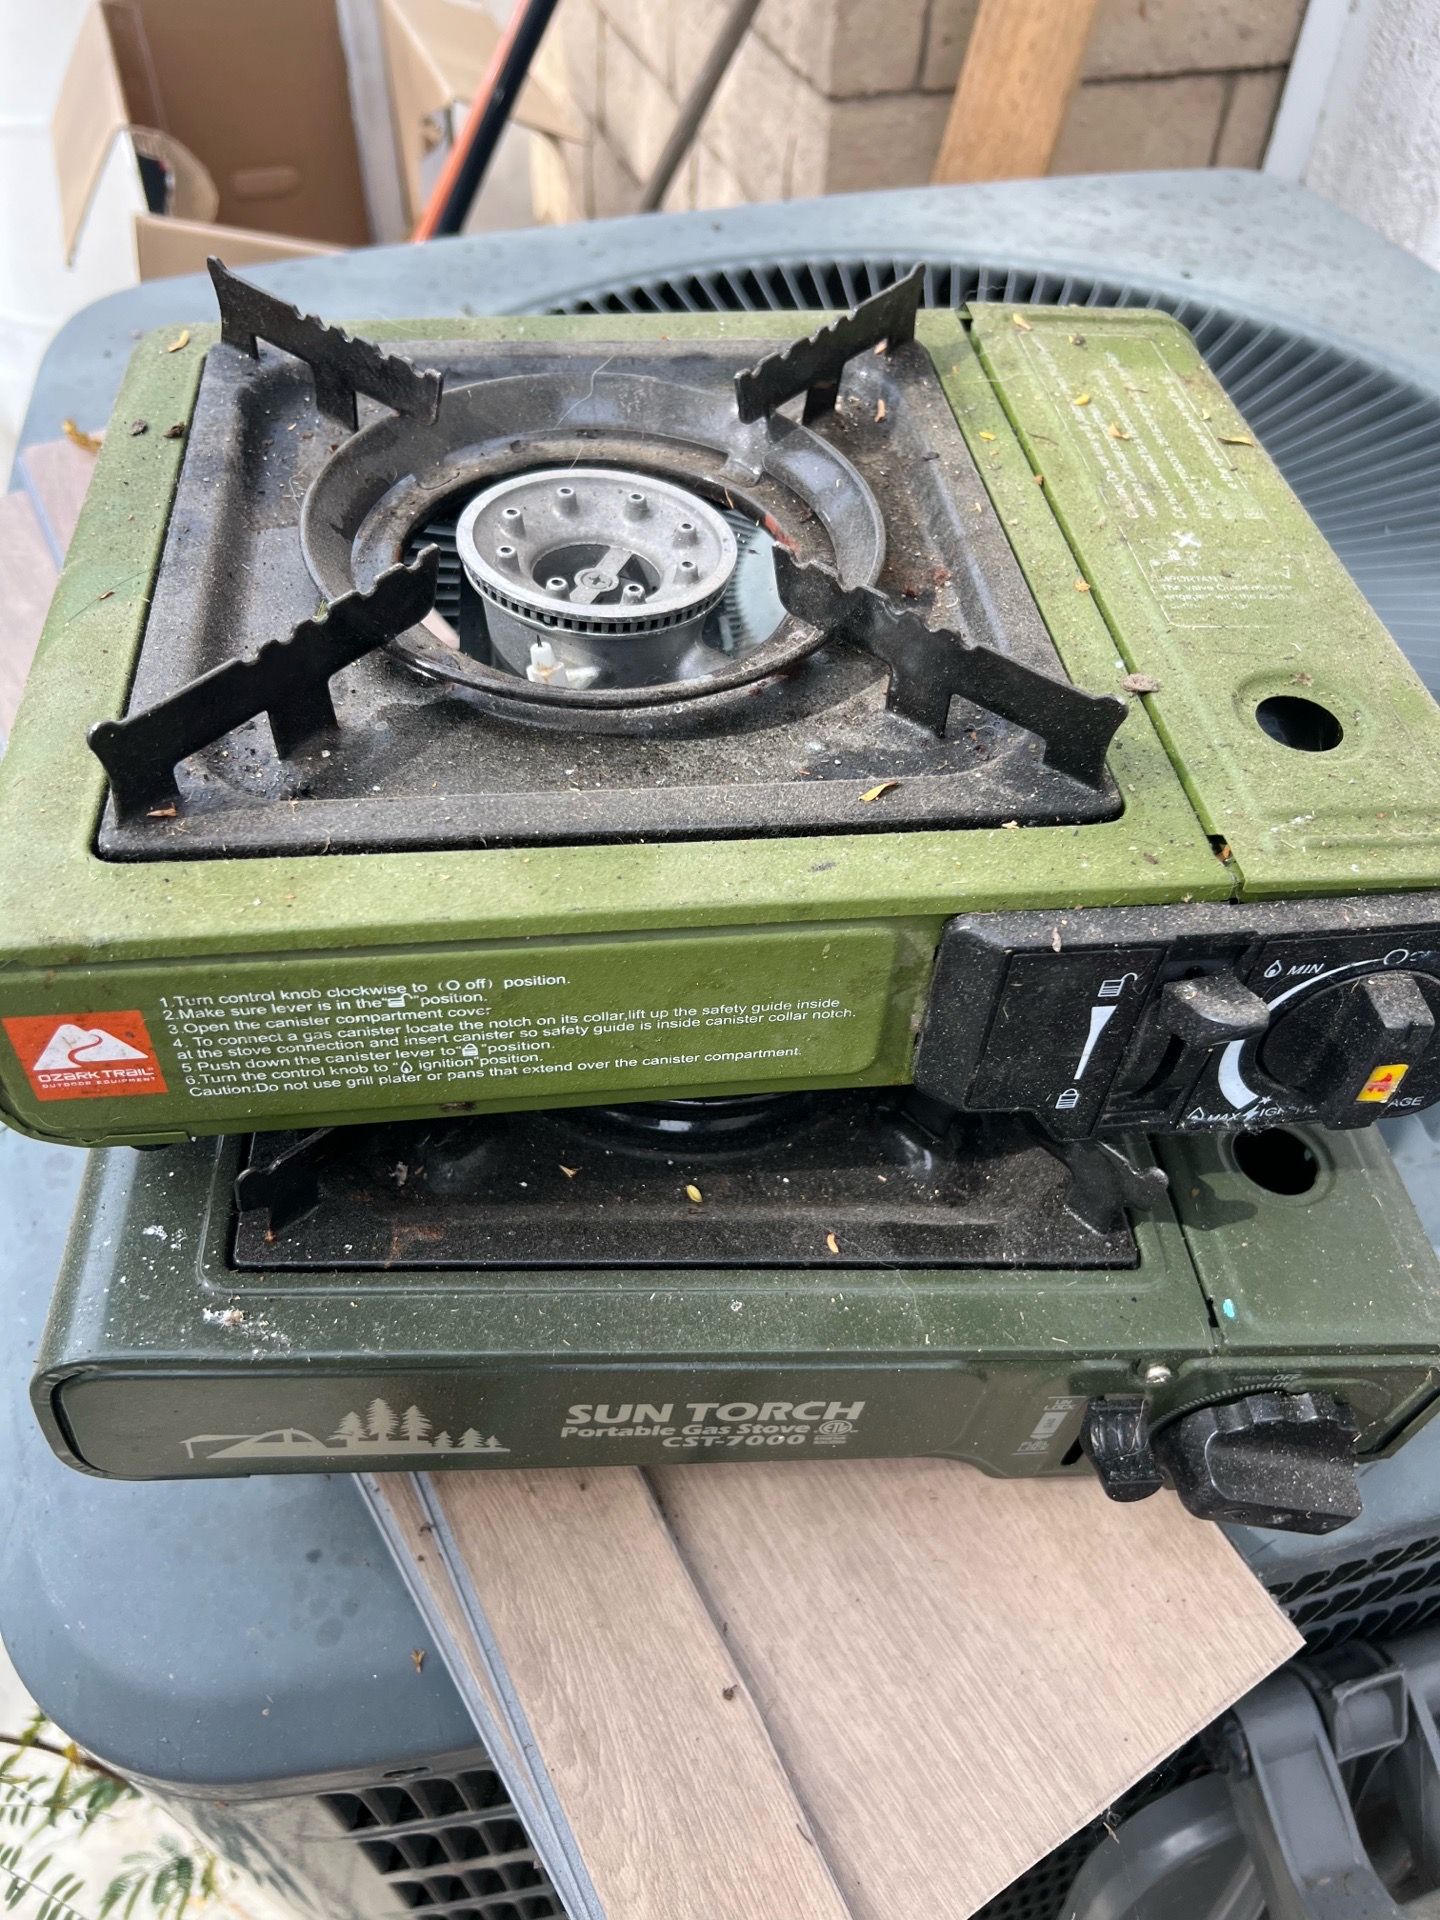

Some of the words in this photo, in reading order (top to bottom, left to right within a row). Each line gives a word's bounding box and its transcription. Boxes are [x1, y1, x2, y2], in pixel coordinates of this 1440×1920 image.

[1286, 962, 1325, 976] MIN
[218, 990, 276, 1005] control
[279, 988, 322, 1002] knob
[327, 982, 407, 998] clockwise
[411, 982, 428, 994] to
[503, 974, 571, 990] position.
[230, 1004, 268, 1017] sure
[271, 1002, 313, 1014] lever
[317, 1000, 332, 1011] is
[336, 999, 351, 1010] in
[234, 1019, 261, 1032] the
[265, 1016, 331, 1029] canister
[336, 1007, 449, 1026] compartment
[177, 1050, 194, 1061] at
[196, 1048, 223, 1060] the
[228, 1045, 272, 1058] stove
[276, 1039, 365, 1054] connection
[369, 1037, 399, 1049] and
[404, 1034, 450, 1046] insert
[453, 1029, 515, 1043] canister
[519, 1029, 538, 1038] so
[542, 1025, 589, 1037] safety
[593, 1020, 635, 1036] guide
[640, 1020, 653, 1031] is
[656, 1017, 701, 1029] inside
[705, 1014, 764, 1027] canister
[768, 1011, 808, 1023] collar
[812, 1008, 857, 1020] notch.
[192, 1036, 213, 1048] To
[217, 1032, 284, 1046] connect
[287, 1033, 299, 1042] a
[302, 1031, 333, 1044] gas
[337, 1024, 401, 1039] canister
[406, 1022, 455, 1035] locate
[458, 1020, 484, 1032] the
[488, 1016, 532, 1029] notch
[536, 1016, 556, 1026] on
[561, 1014, 579, 1025] its
[649, 1009, 669, 1021] up
[674, 1006, 698, 1017] the
[702, 1003, 747, 1016] safety
[751, 1000, 792, 1014] guide
[796, 998, 840, 1010] inside
[244, 1057, 291, 1070] down
[294, 1054, 321, 1066] the
[325, 1047, 391, 1064] canister
[395, 1048, 435, 1060] lever
[283, 1081, 309, 1091] not
[312, 1078, 342, 1089] use
[346, 1075, 374, 1088] grill
[378, 1073, 422, 1086] plater
[426, 1071, 444, 1081] or
[447, 1068, 485, 1082] pans
[489, 1066, 518, 1077] that
[522, 1062, 573, 1075] extend
[577, 1059, 611, 1071] over
[614, 1058, 638, 1069] the
[642, 1054, 700, 1066] canister
[704, 1046, 802, 1062] compartment.
[241, 1071, 268, 1082] the
[271, 1067, 326, 1080] control
[329, 1064, 369, 1076] knob
[373, 1063, 389, 1073] to
[1206, 1112, 1241, 1121] MAX
[565, 1403, 675, 1425] SUN
[685, 1400, 867, 1423] TORCH
[560, 1424, 675, 1438] Portable
[682, 1423, 732, 1436] Gas
[736, 1423, 811, 1435] Stove
[662, 1433, 806, 1448] CST-7000
